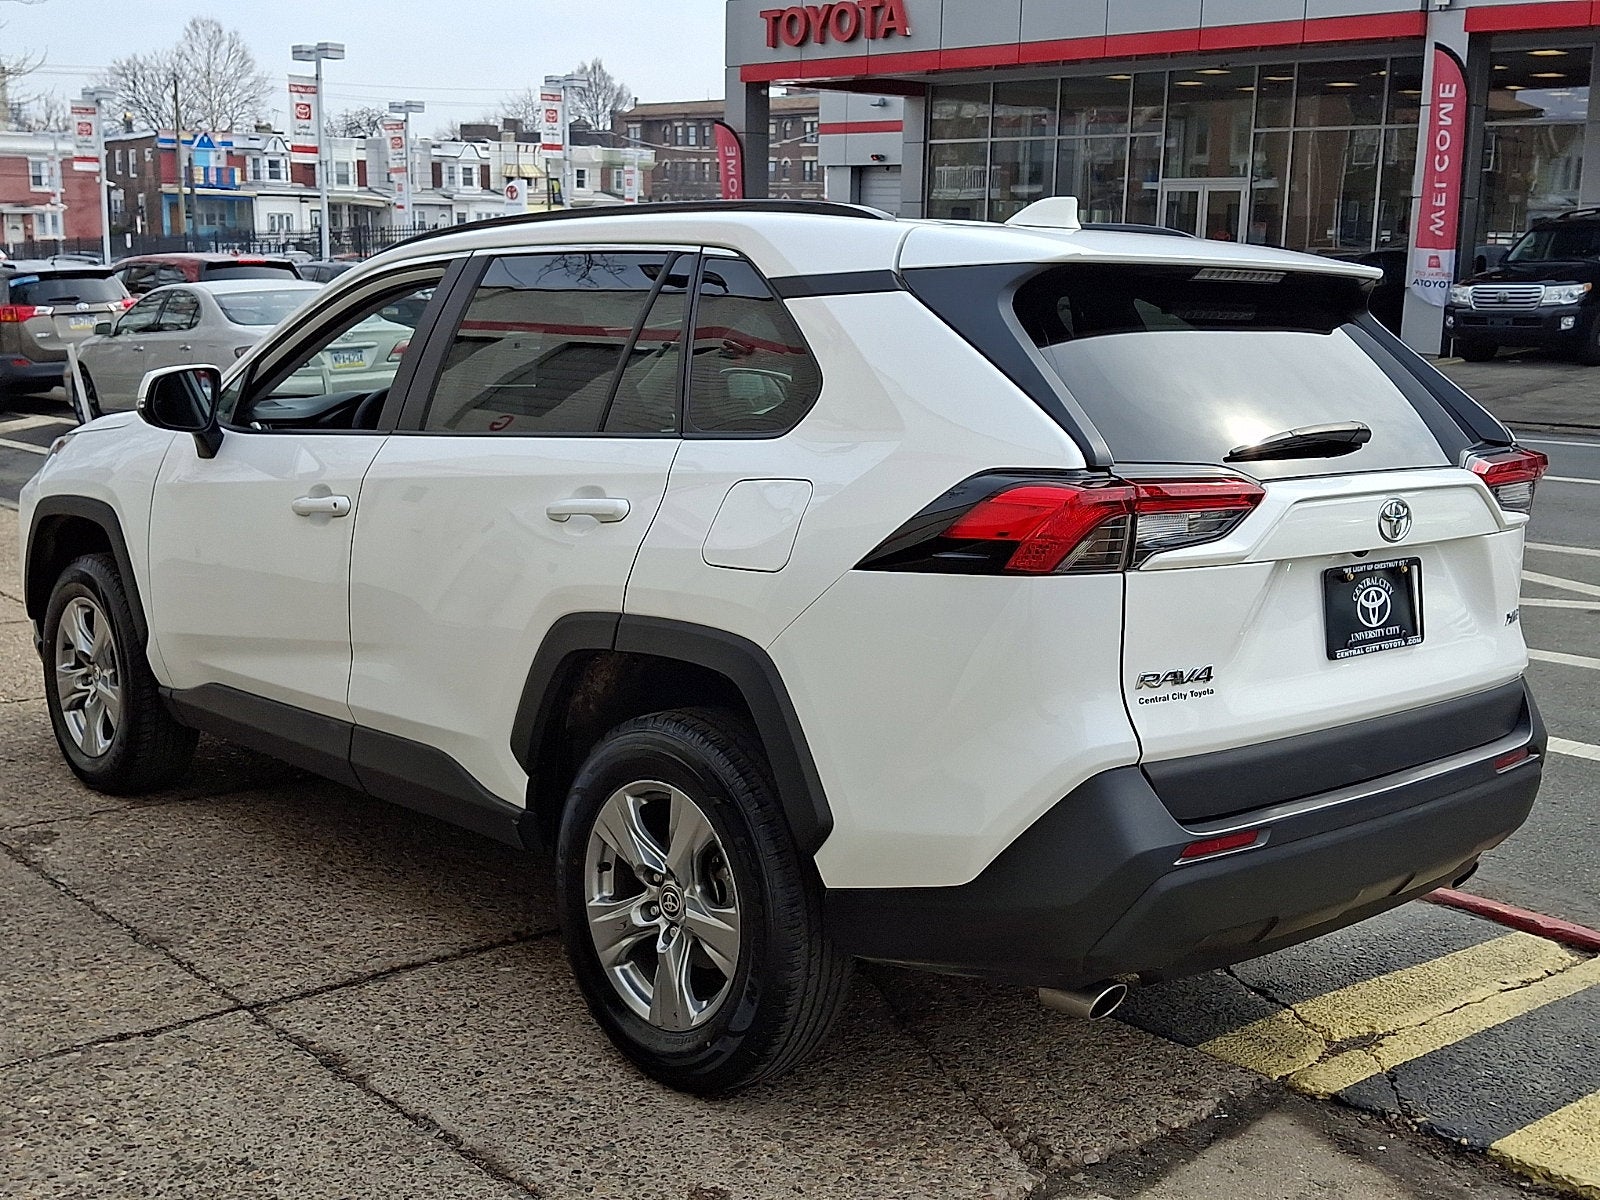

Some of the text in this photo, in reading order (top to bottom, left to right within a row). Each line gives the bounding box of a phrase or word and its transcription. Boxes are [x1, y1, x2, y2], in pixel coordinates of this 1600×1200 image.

[760, 0, 911, 48] TOYOTA
[1374, 560, 1398, 570] CHESTNUT
[1352, 576, 1395, 602] CENTRAL CITY
[1351, 625, 1401, 642] UNIVERSITY CITY
[1336, 649, 1365, 659] CENTRAL
[1365, 645, 1380, 653] CITY
[1380, 640, 1406, 650] TOYOTA
[1135, 663, 1215, 690] RAV4
[1138, 687, 1215, 705] Central City Toyota
